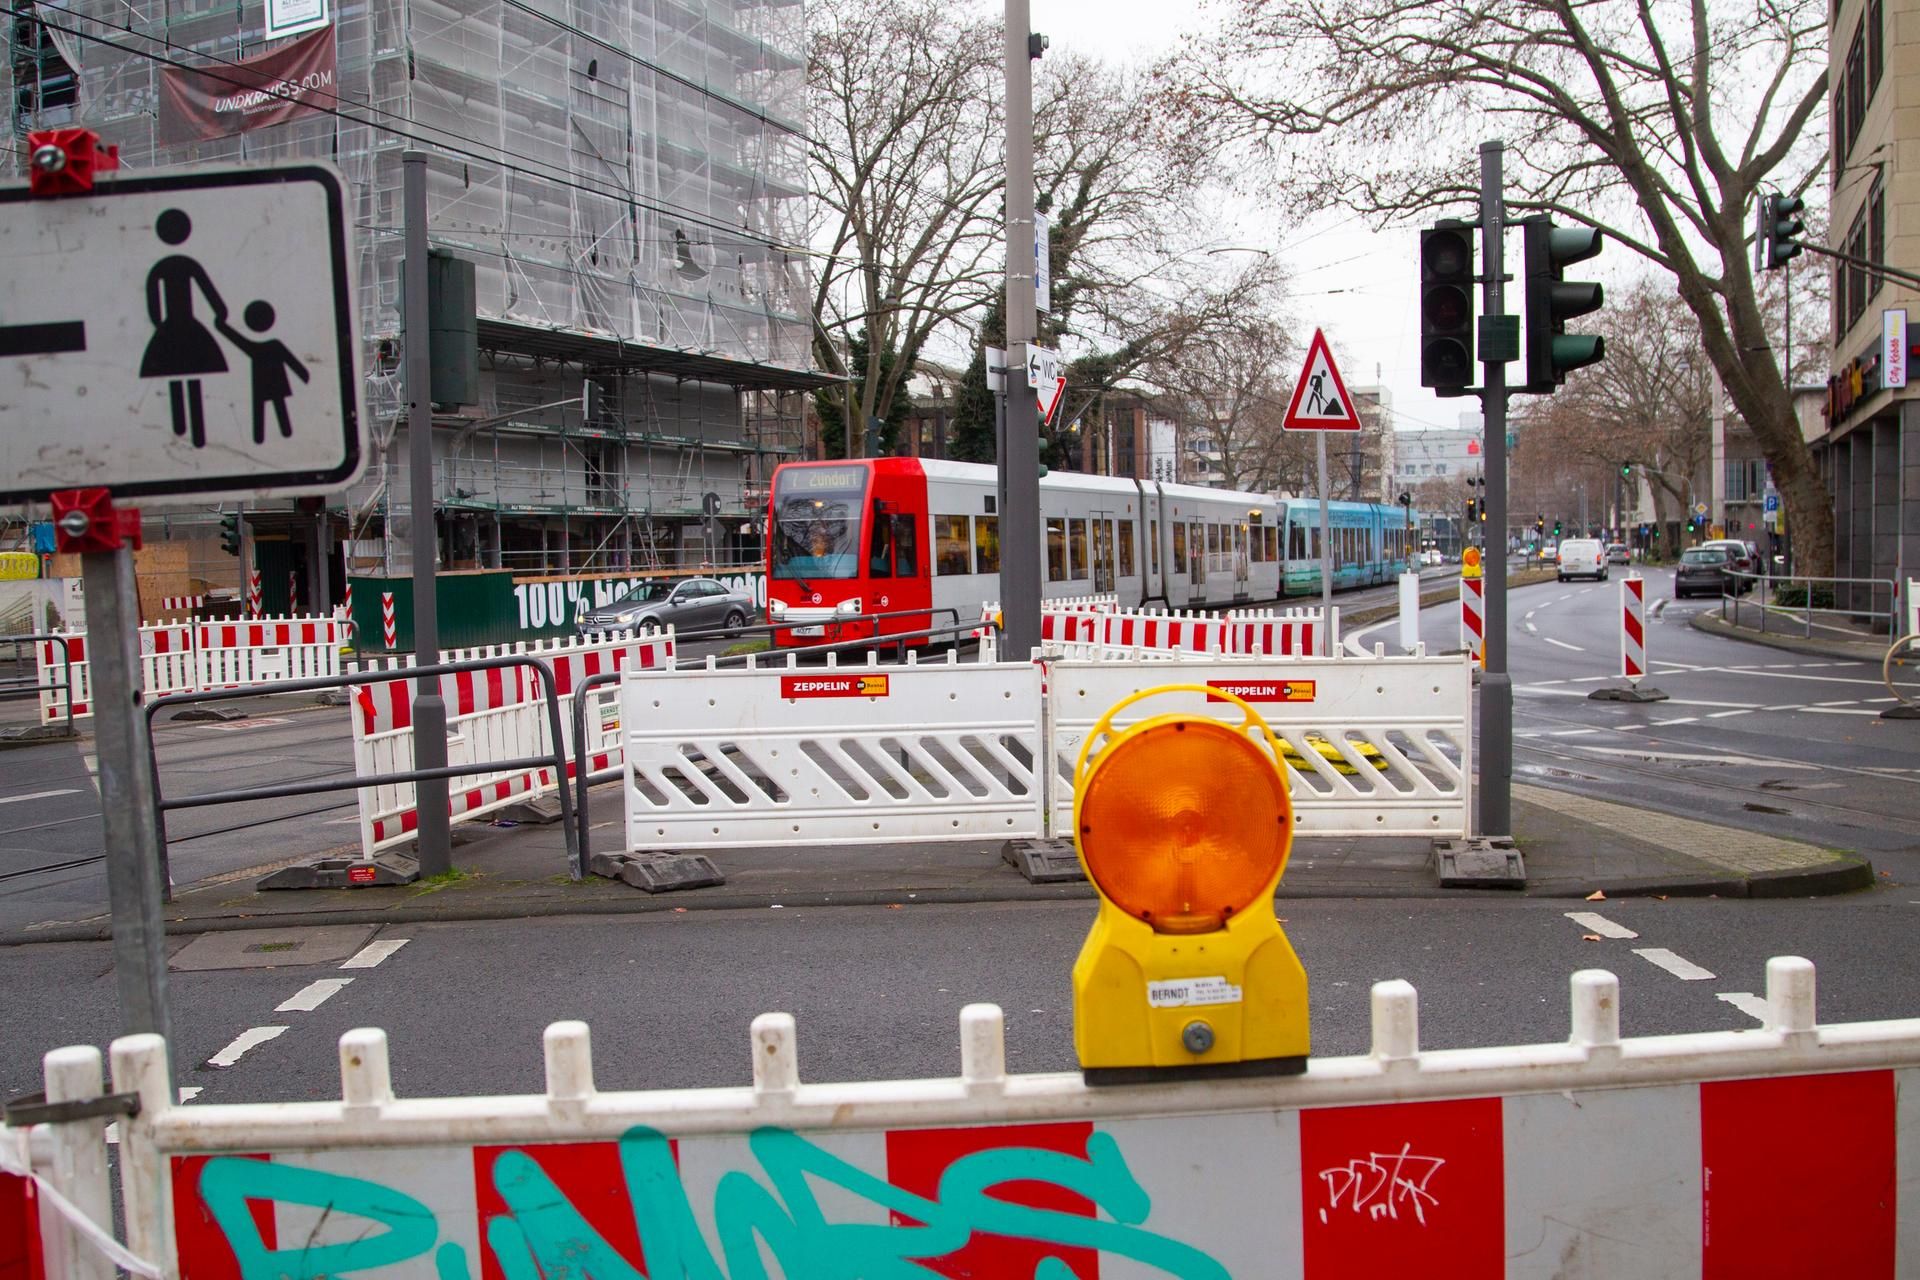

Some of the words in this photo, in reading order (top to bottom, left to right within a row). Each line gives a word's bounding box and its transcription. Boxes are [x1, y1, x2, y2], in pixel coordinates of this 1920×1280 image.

[1042, 360, 1056, 380] WC
[793, 681, 850, 692] ZEPPELIN
[1151, 987, 1190, 1001] BERNDT
